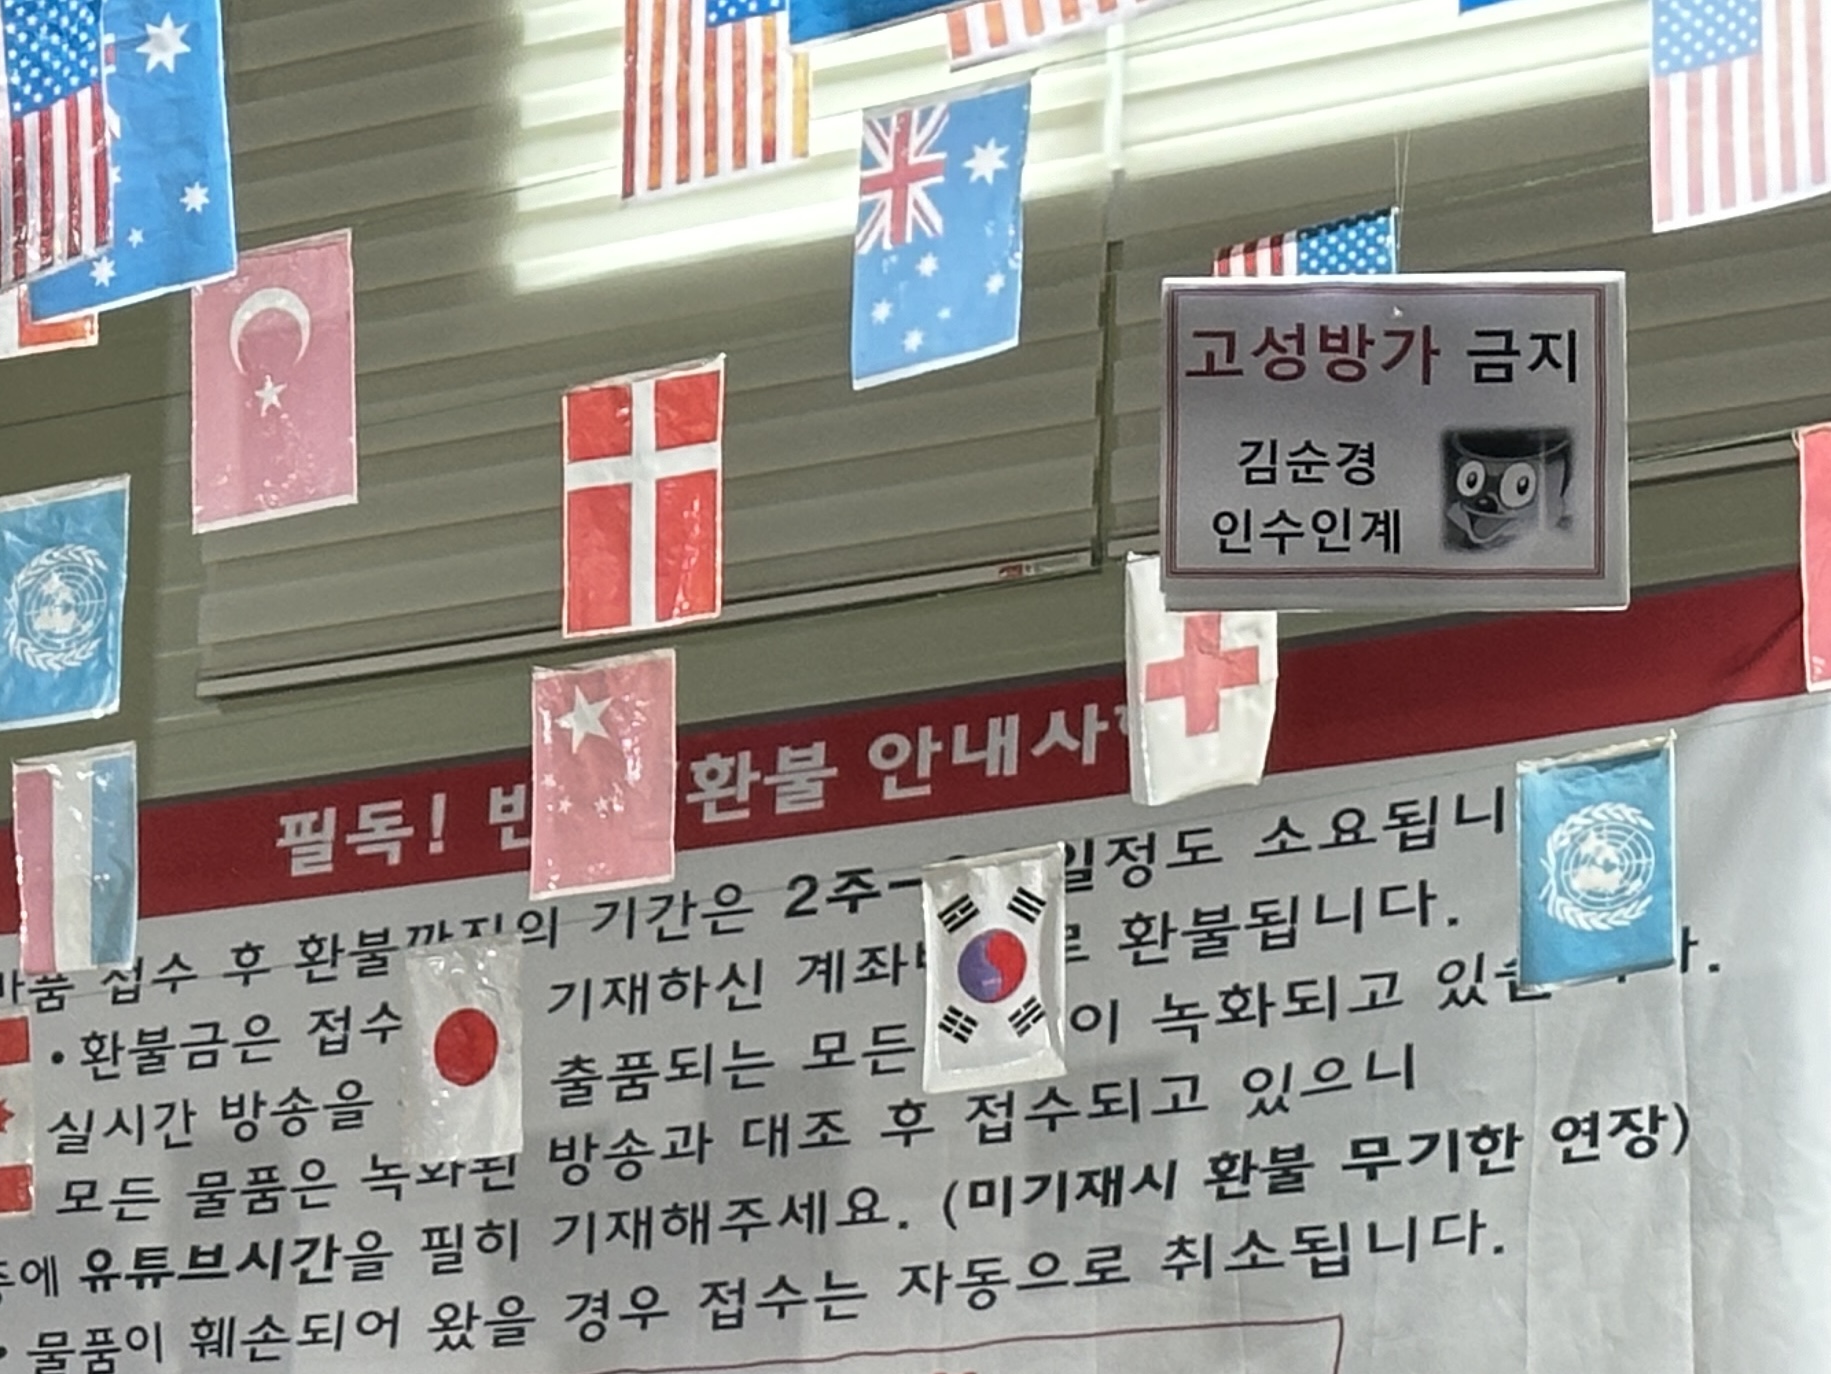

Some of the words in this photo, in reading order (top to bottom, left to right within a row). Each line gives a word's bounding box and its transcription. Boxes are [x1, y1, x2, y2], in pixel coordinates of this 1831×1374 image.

[1185, 323, 1440, 385] 고성방가
[1467, 329, 1576, 383] 금지
[1213, 508, 1400, 555] 인수인계
[1238, 439, 1375, 485] 김순경
[276, 793, 446, 876] 필독!
[685, 741, 838, 824] 환불
[868, 703, 1130, 801] 안내사
[221, 941, 272, 987] 후
[591, 883, 754, 943] 기간은
[1254, 786, 1506, 860] 소요됩니
[47, 1098, 197, 1155] 실시간
[221, 1079, 374, 1143] 방송을
[550, 1044, 775, 1109] 출품되는
[802, 1024, 916, 1076] 모든
[1152, 971, 1404, 1044] 녹화되고
[80, 1014, 281, 1082] 환불금은
[306, 1003, 405, 1056] 접수
[548, 958, 763, 1021] 기재하신
[1118, 879, 1458, 967] 환불됩니다.
[56, 1177, 160, 1221] 모든
[186, 1158, 338, 1219] 물품은
[549, 1122, 714, 1186] 방송과
[742, 1110, 851, 1158] 대조
[880, 1098, 935, 1148] 후
[965, 1074, 1209, 1145] 접수되고
[1243, 1043, 1414, 1119] 있으니
[79, 1230, 394, 1293] 유튜브시간을
[420, 1219, 518, 1276] 필히
[552, 1186, 908, 1255] 기재해주세요.
[943, 1159, 1177, 1231] (미기재시
[1203, 1143, 1315, 1202] 환불
[1341, 1122, 1524, 1182] 무기한
[1551, 1102, 1690, 1165] 연장)
[189, 1306, 400, 1363] 훼손되어
[427, 1295, 536, 1352] 왔을
[565, 1286, 669, 1343] 경우
[699, 1270, 868, 1331] 접수는
[897, 1244, 1131, 1311] 자동으로
[1161, 1209, 1504, 1281] 취소됩니다.
